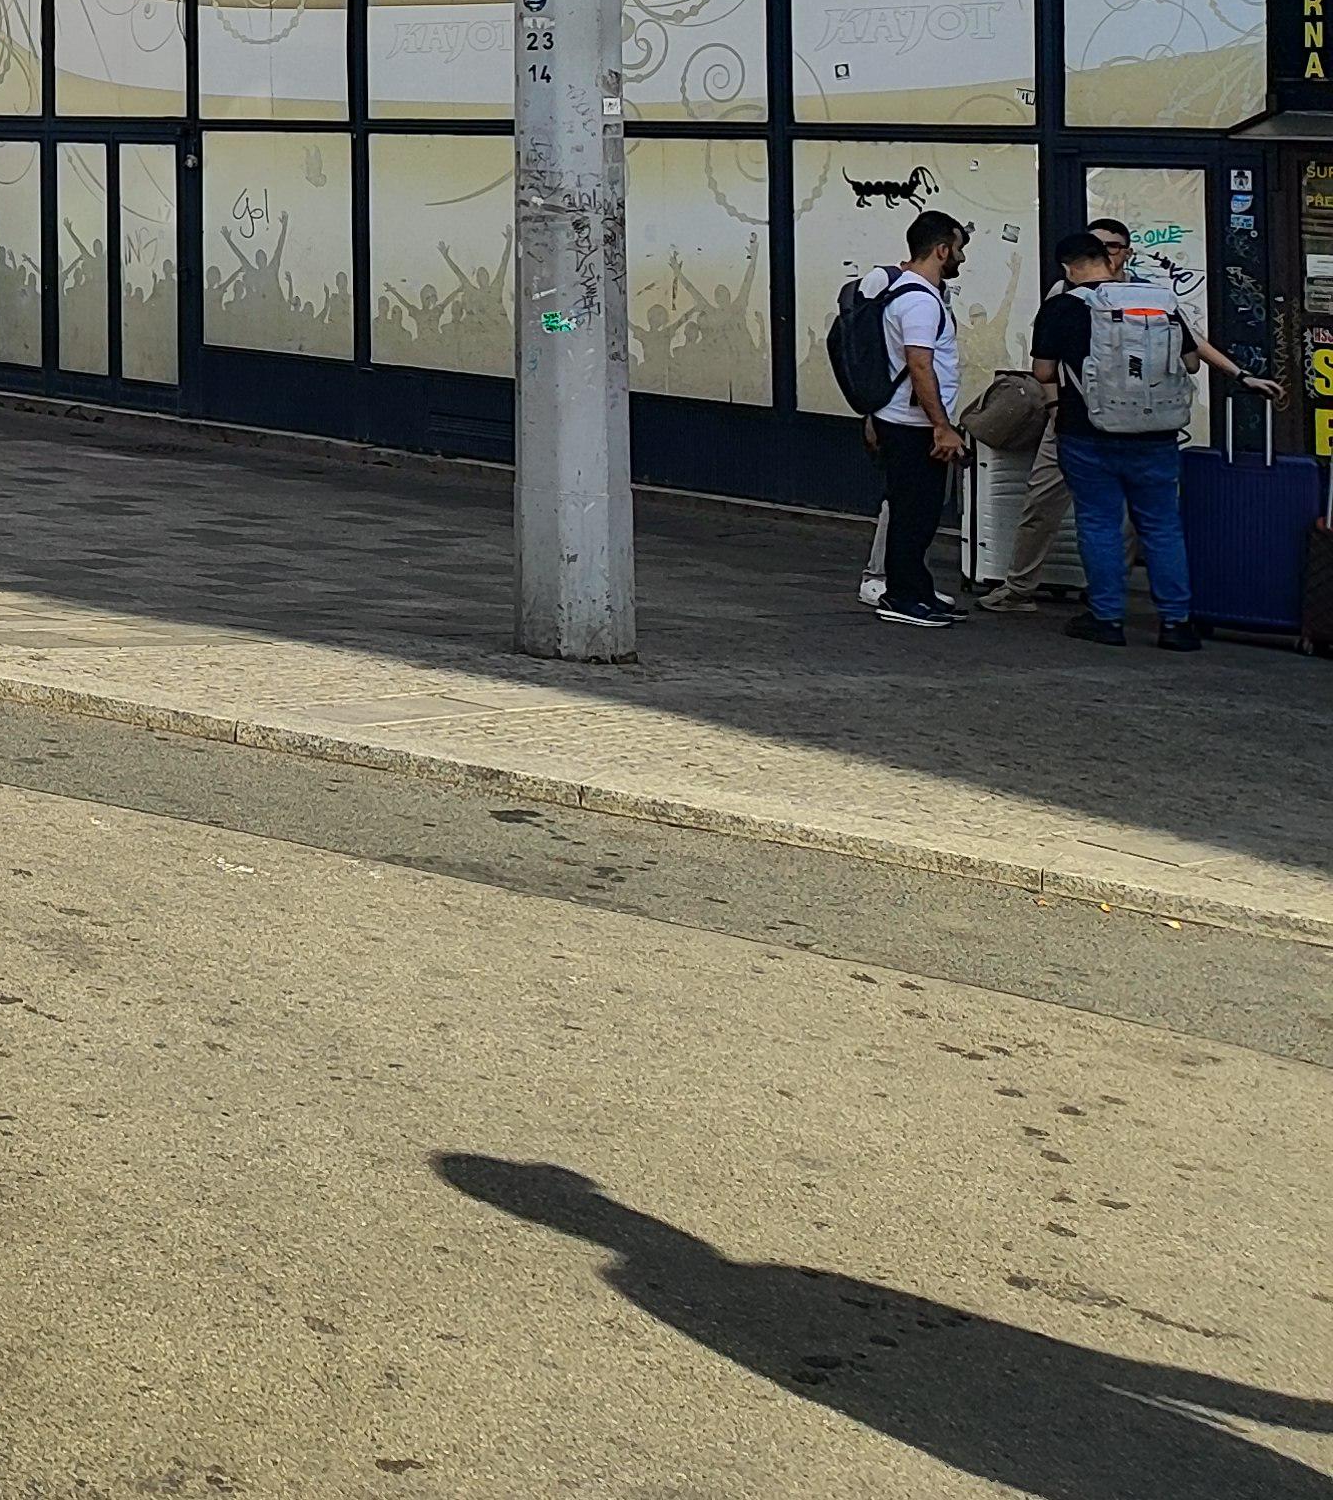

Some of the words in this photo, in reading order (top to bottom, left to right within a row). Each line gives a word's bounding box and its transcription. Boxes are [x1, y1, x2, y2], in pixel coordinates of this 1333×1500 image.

[812, 1, 1006, 56] KAJOT
[526, 31, 555, 51] 23
[528, 64, 552, 84] 14
